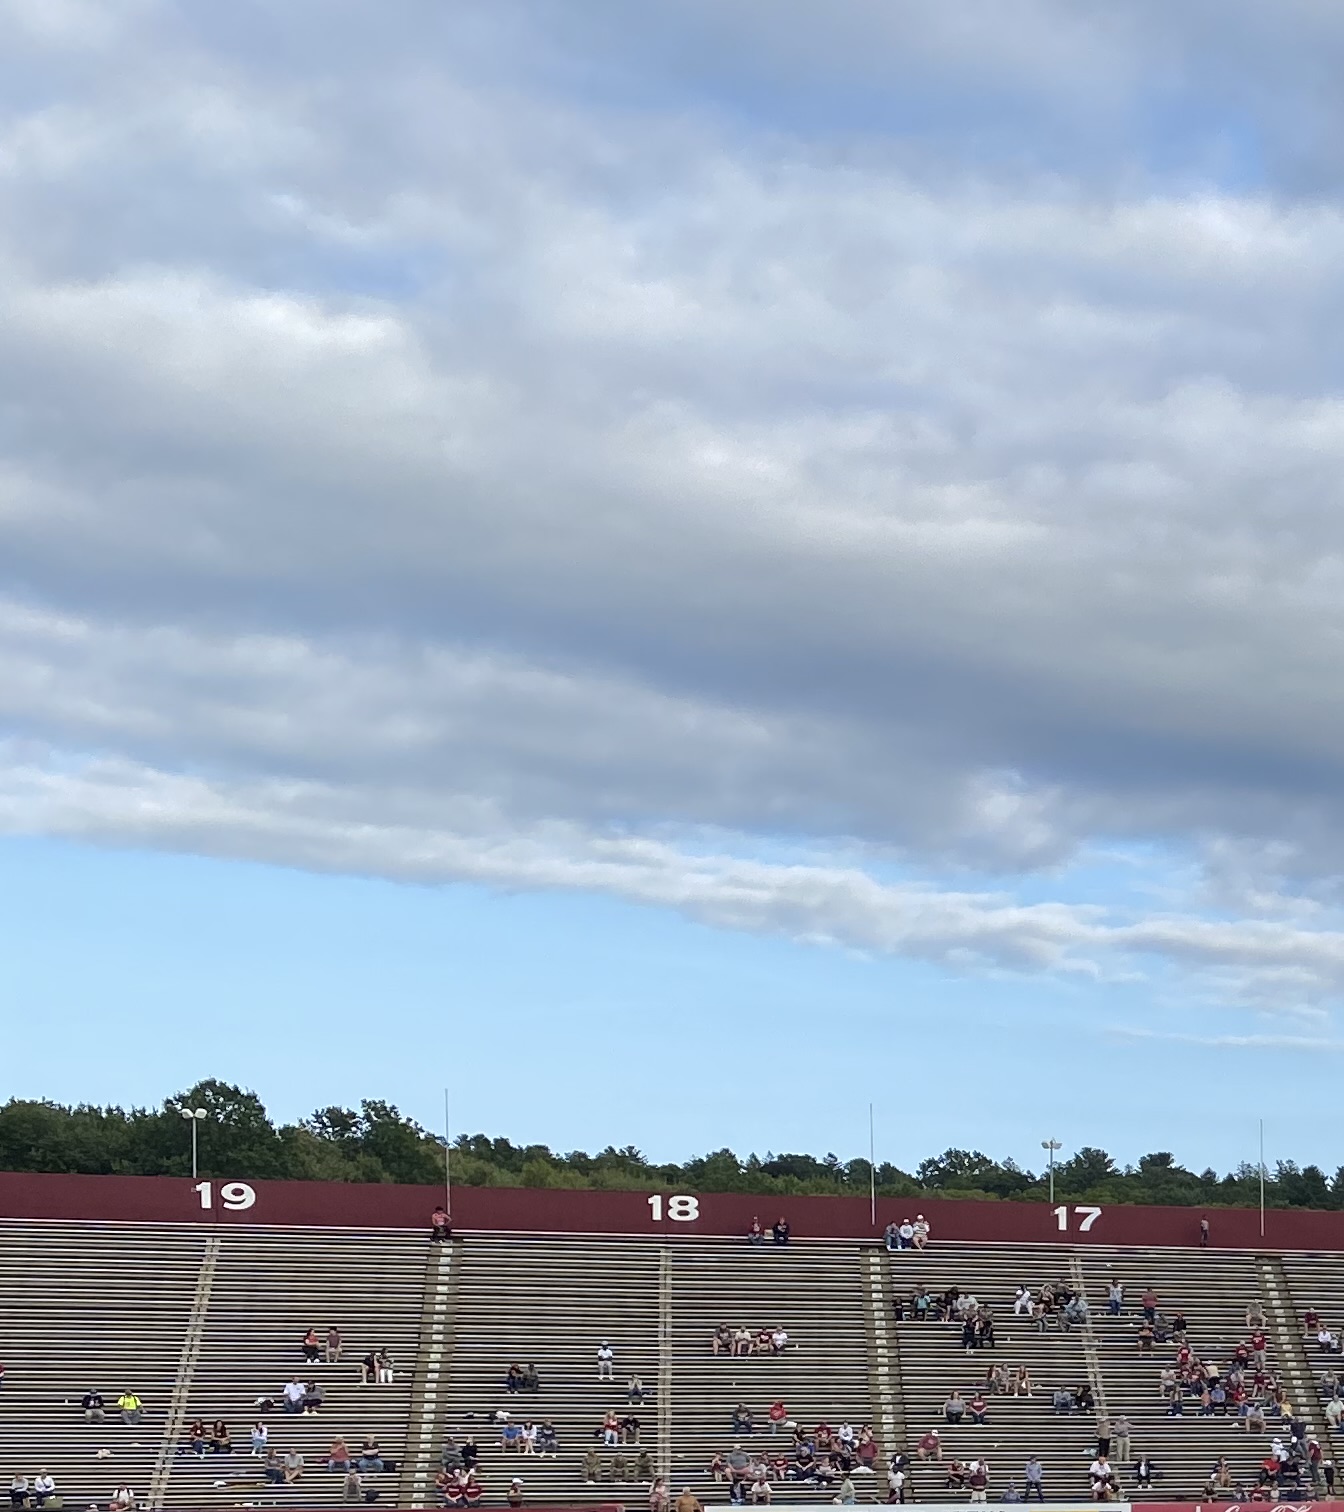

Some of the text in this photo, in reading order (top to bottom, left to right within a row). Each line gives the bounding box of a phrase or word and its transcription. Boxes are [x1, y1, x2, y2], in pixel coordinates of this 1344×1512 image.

[195, 1181, 256, 1211] 19
[647, 1194, 700, 1222] 18
[1053, 1206, 1103, 1232] 17
